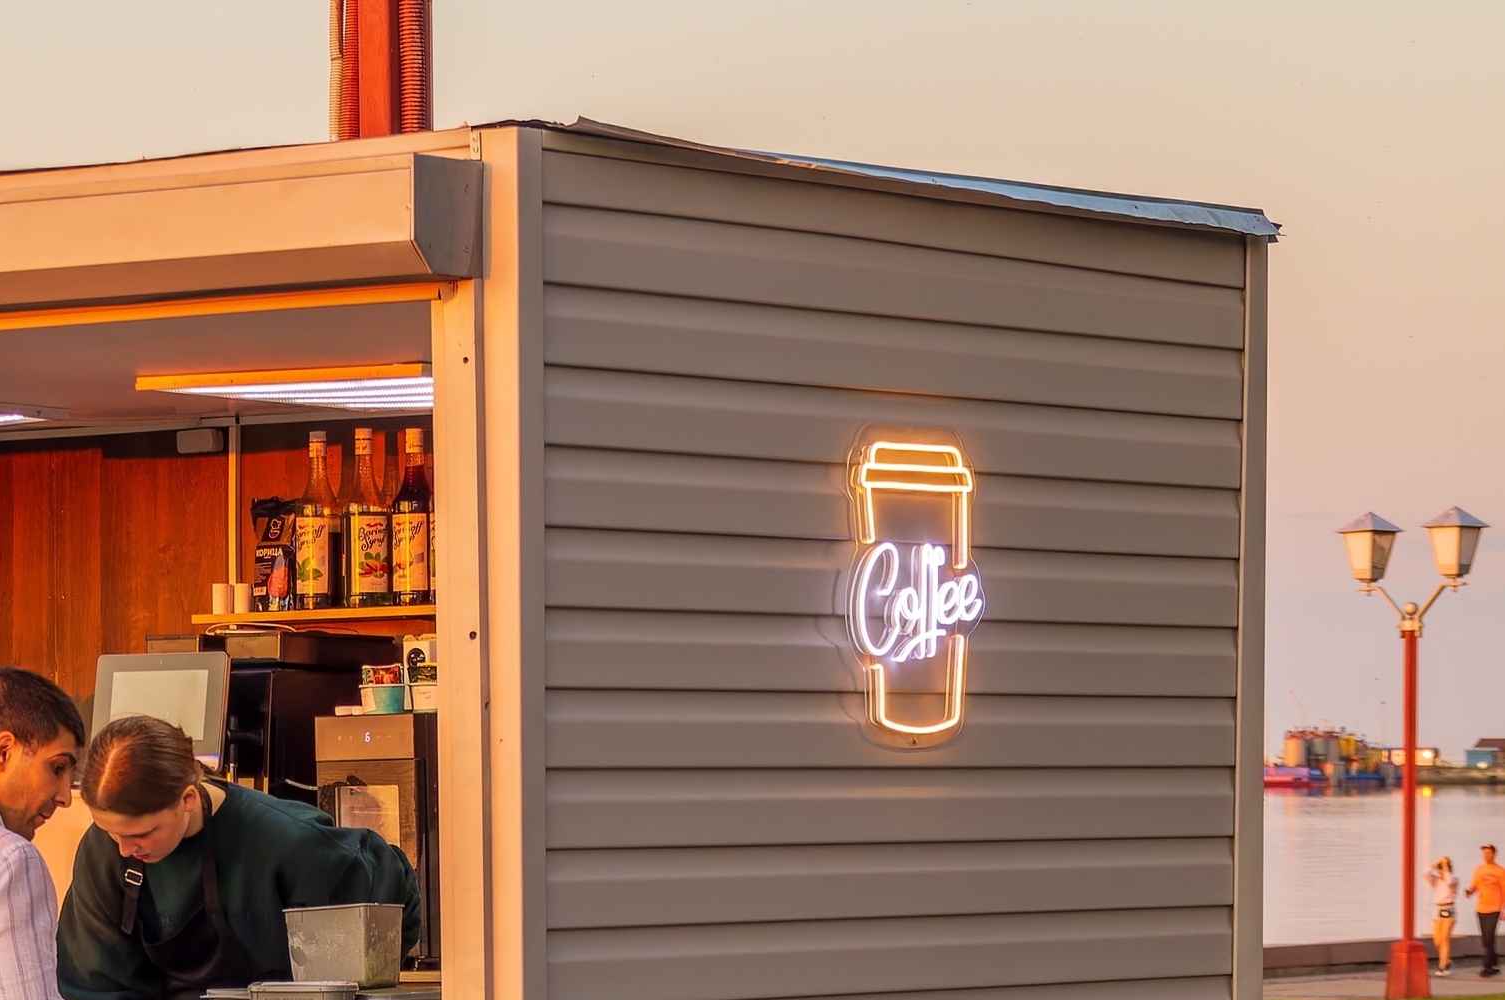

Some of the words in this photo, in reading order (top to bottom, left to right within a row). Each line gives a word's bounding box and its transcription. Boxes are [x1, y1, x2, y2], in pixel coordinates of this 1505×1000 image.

[256, 547, 283, 558] КОРИЦА
[852, 541, 983, 662] Coffee
[364, 732, 371, 742] 6
